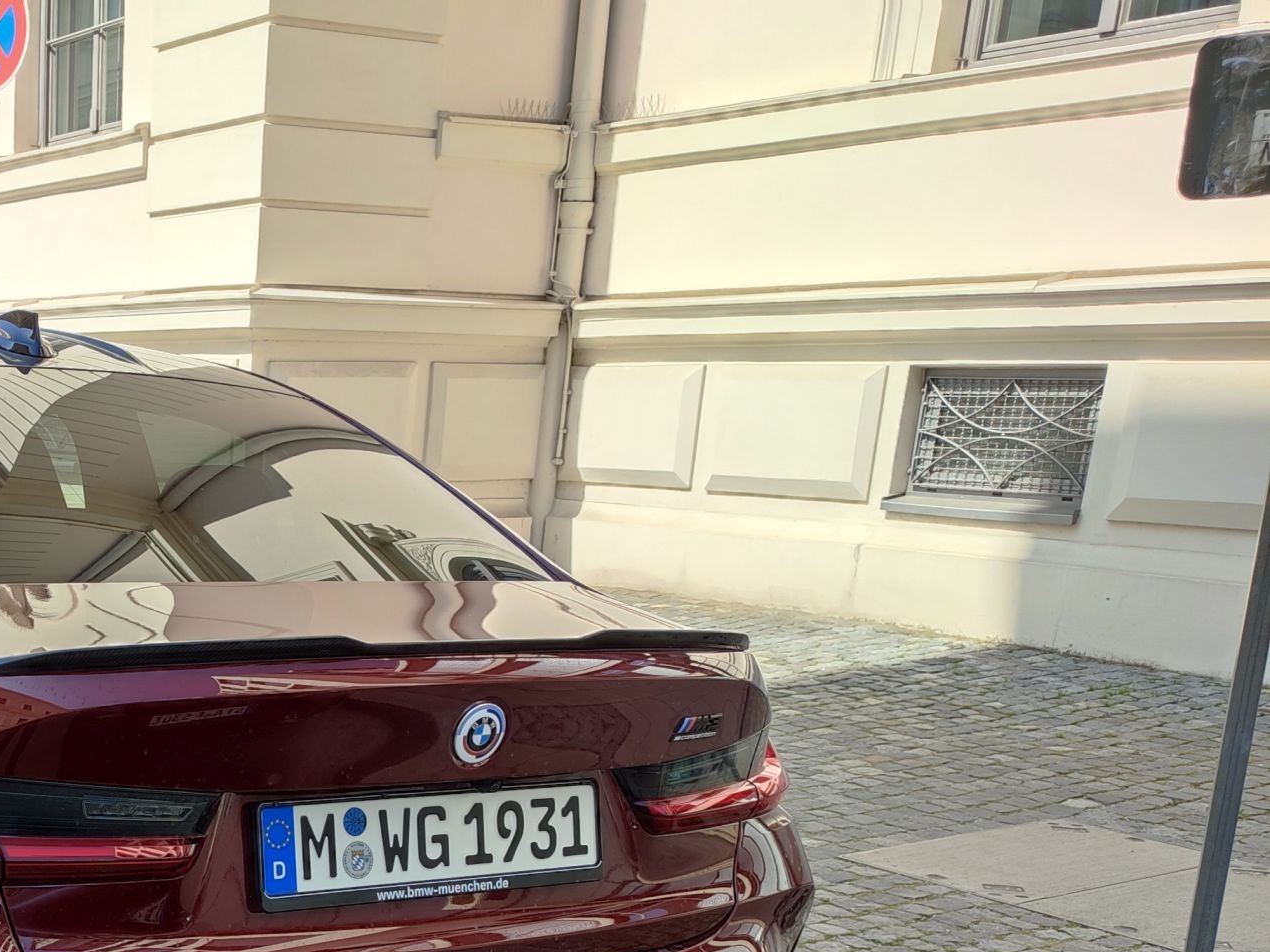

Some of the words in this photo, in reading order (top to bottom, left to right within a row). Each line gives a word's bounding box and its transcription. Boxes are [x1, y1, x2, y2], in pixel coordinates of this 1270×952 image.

[472, 716, 497, 729] BMW
[300, 813, 337, 880] M
[378, 806, 450, 873] WG
[463, 795, 589, 866] 1931
[273, 861, 286, 880] D
[376, 878, 509, 902] www.bmw-muenchen.de
